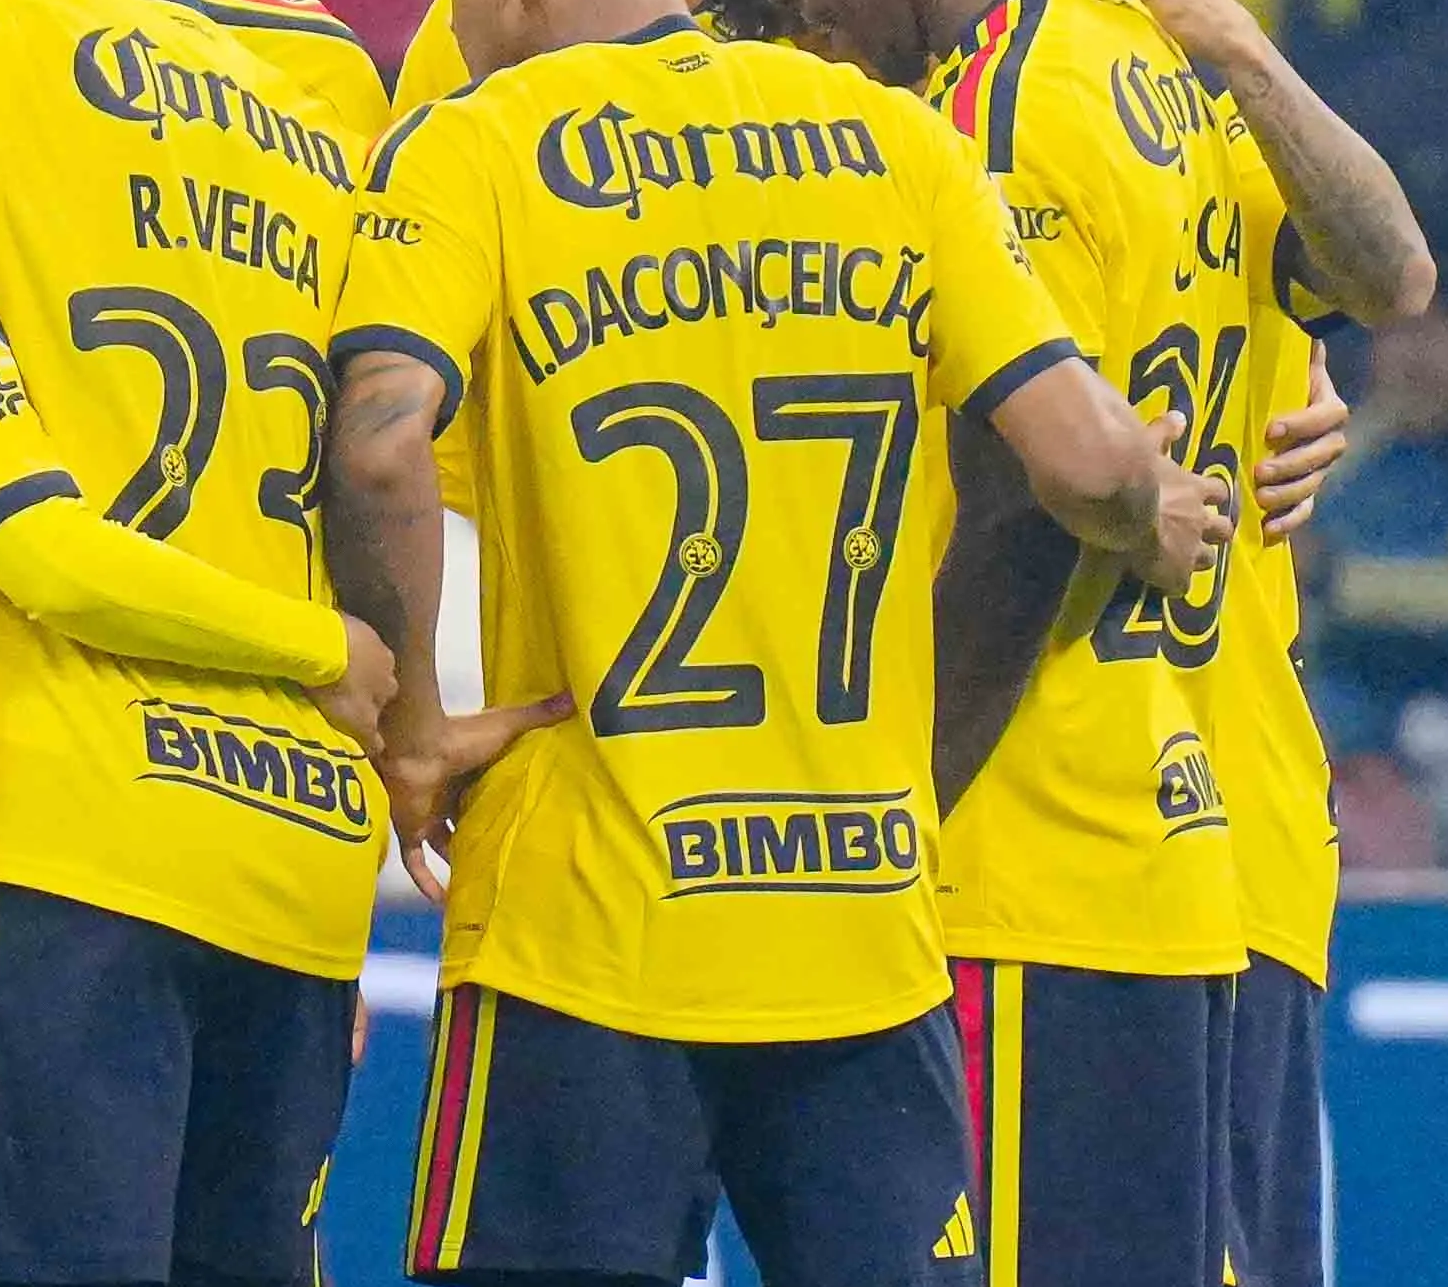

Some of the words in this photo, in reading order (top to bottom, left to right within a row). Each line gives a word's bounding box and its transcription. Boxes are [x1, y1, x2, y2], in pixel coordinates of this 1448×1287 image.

[72, 26, 355, 194] Corona
[536, 101, 887, 220] Corona
[128, 173, 321, 310] R.VEIGA
[569, 370, 920, 739] 27
[142, 712, 371, 827] BIMBO
[665, 808, 918, 881] BIMBO
